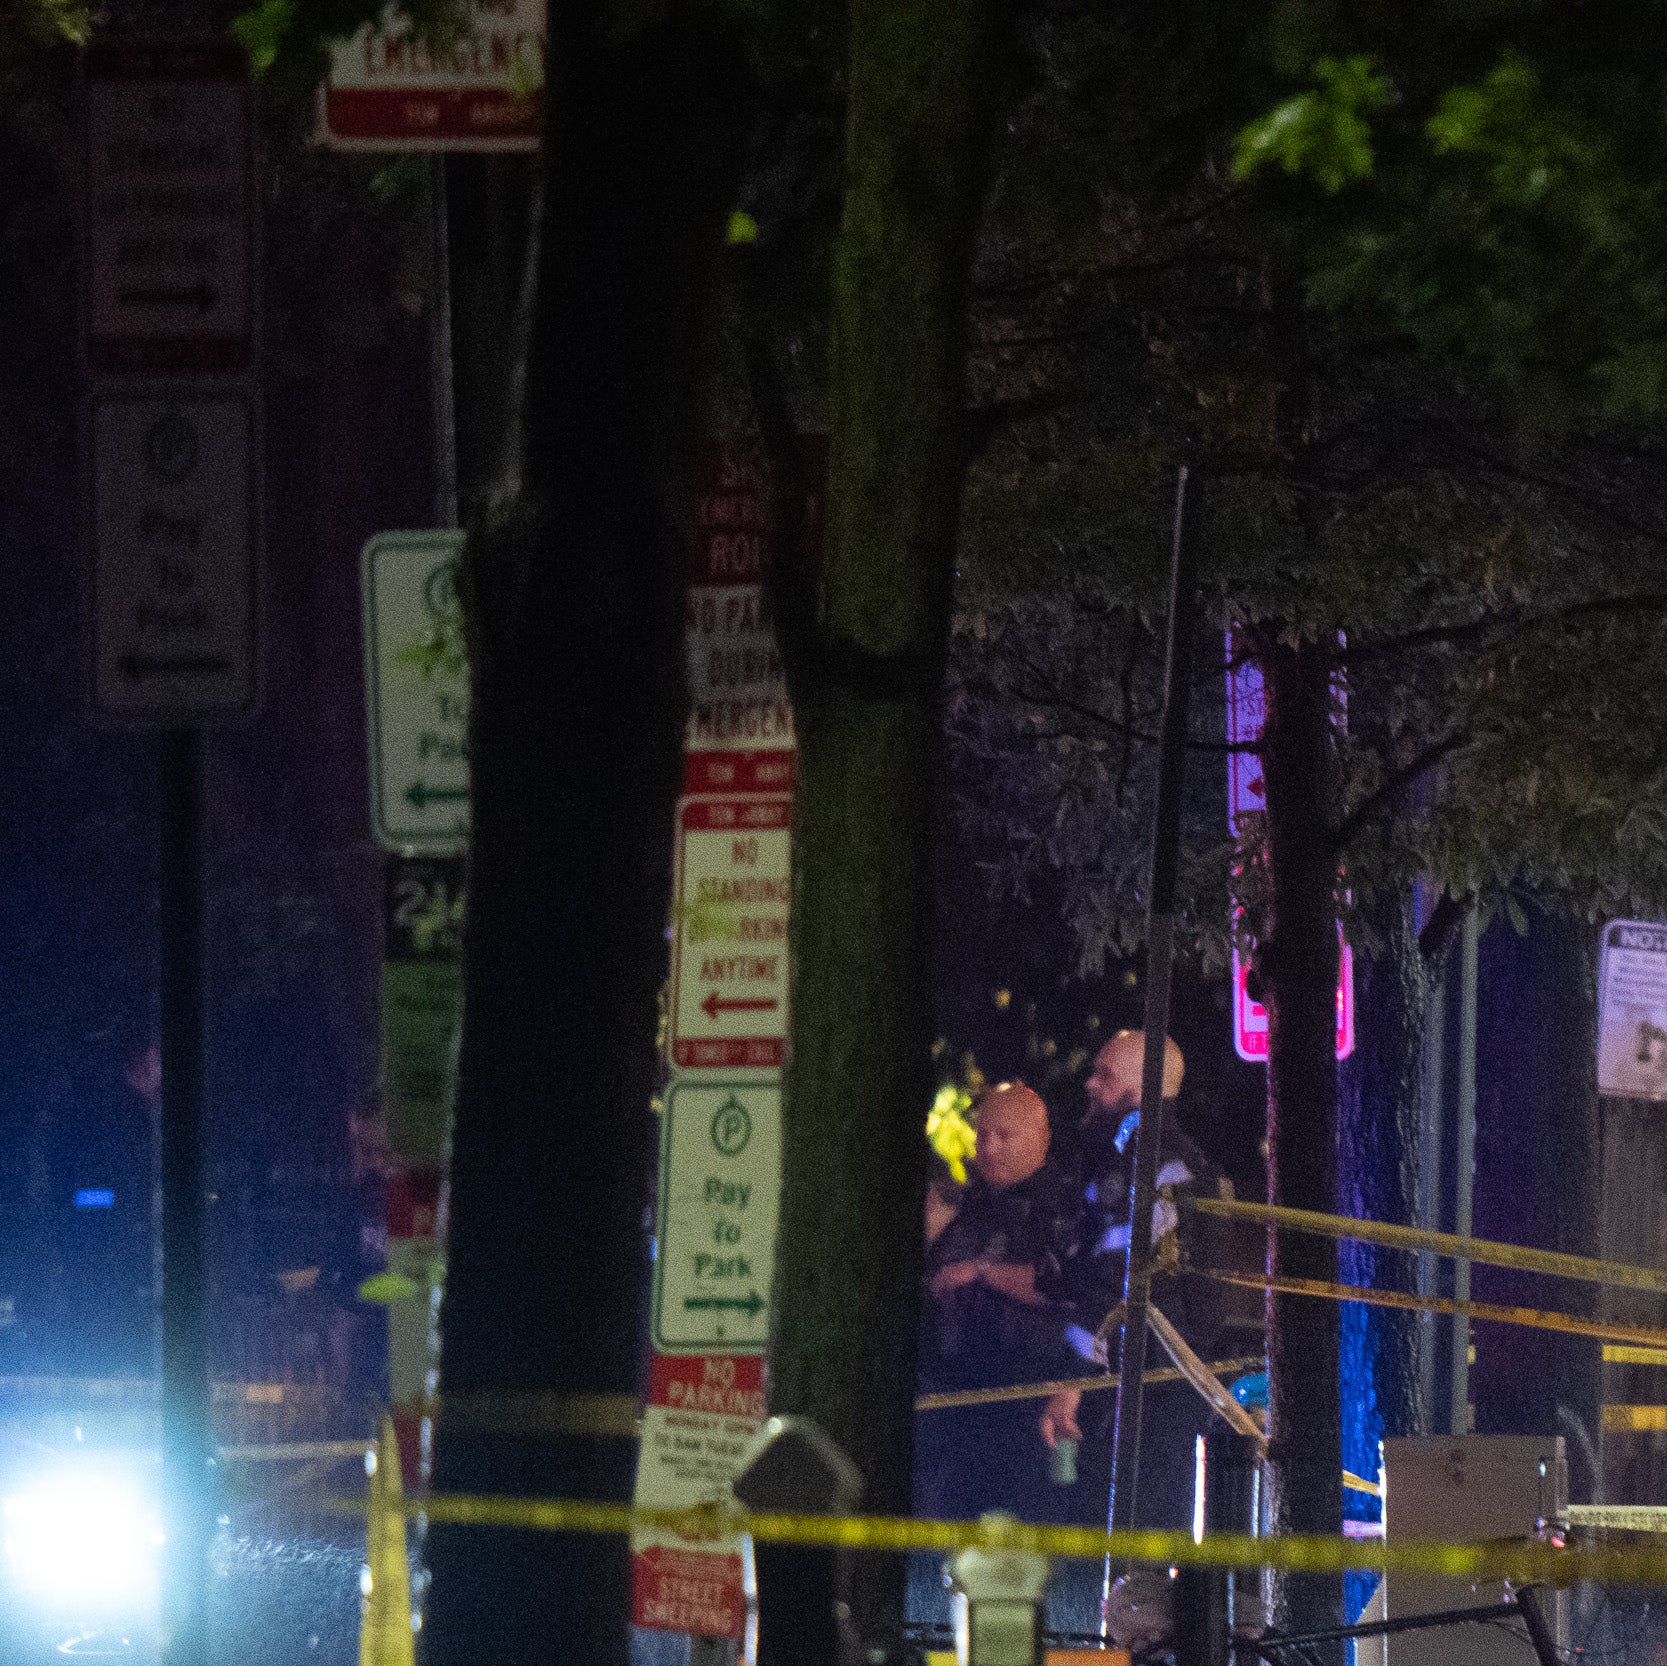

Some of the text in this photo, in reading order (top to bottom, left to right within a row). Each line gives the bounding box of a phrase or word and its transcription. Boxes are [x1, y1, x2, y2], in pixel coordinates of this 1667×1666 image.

[704, 1176, 750, 1210] Pay
[694, 1252, 750, 1279] Park
[703, 1357, 736, 1388] NO
[667, 1380, 767, 1416] PARKING
[659, 1576, 724, 1605] STREET
[643, 1599, 733, 1634] SWEEPING
